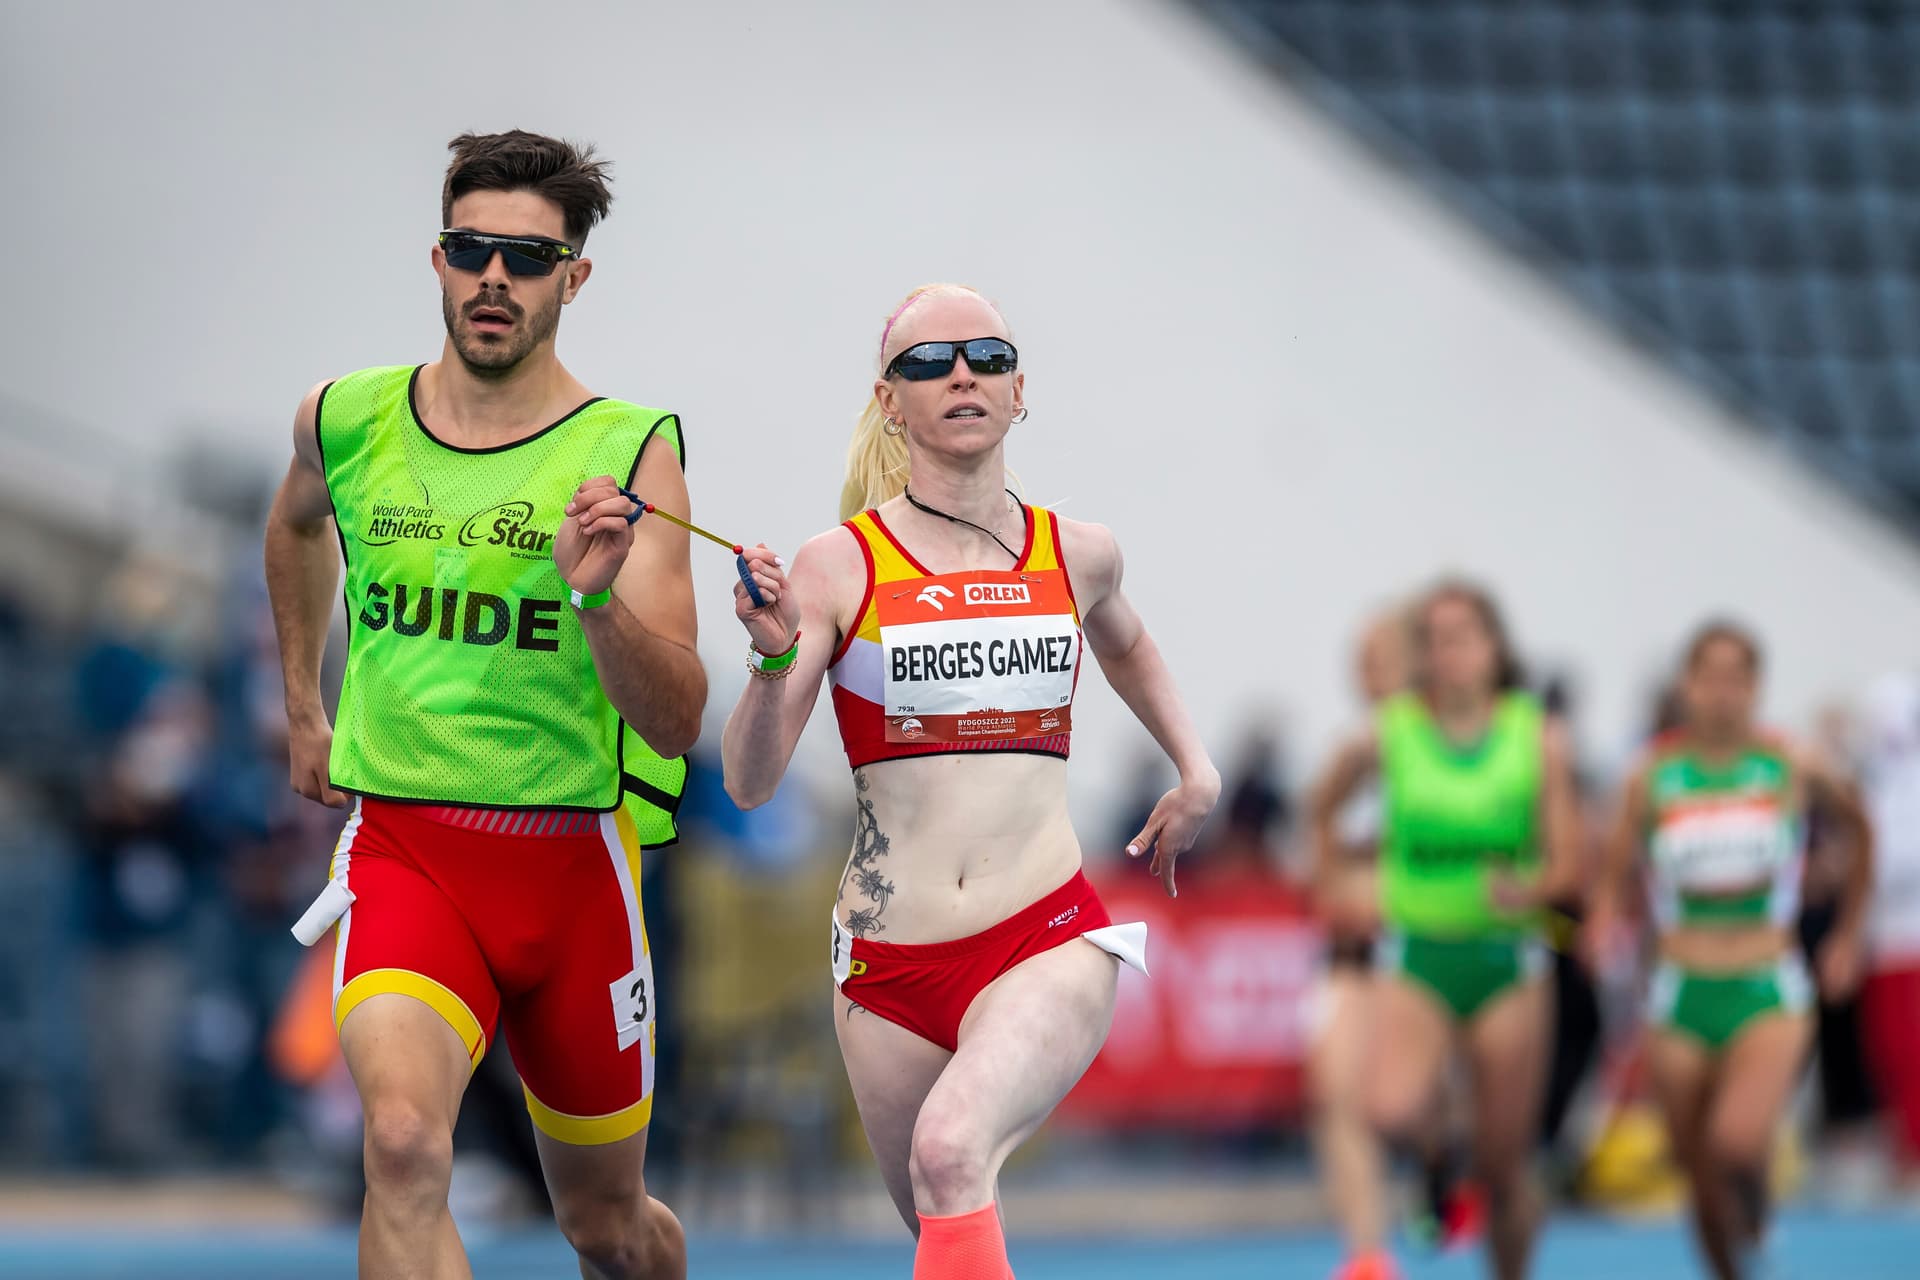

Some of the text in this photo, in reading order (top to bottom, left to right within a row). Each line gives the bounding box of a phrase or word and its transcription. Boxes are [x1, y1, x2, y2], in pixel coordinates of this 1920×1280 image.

[373, 504, 433, 518] World Para
[499, 508, 524, 518] PZSN
[368, 518, 446, 540] Athletics
[487, 518, 556, 551] Star
[968, 586, 1026, 602] ORLEN
[359, 582, 561, 653] GUIDE
[891, 635, 1073, 682] BERGES GAMEZ
[957, 718, 999, 726] BYDGOSZCZ
[630, 978, 648, 1023] 3
